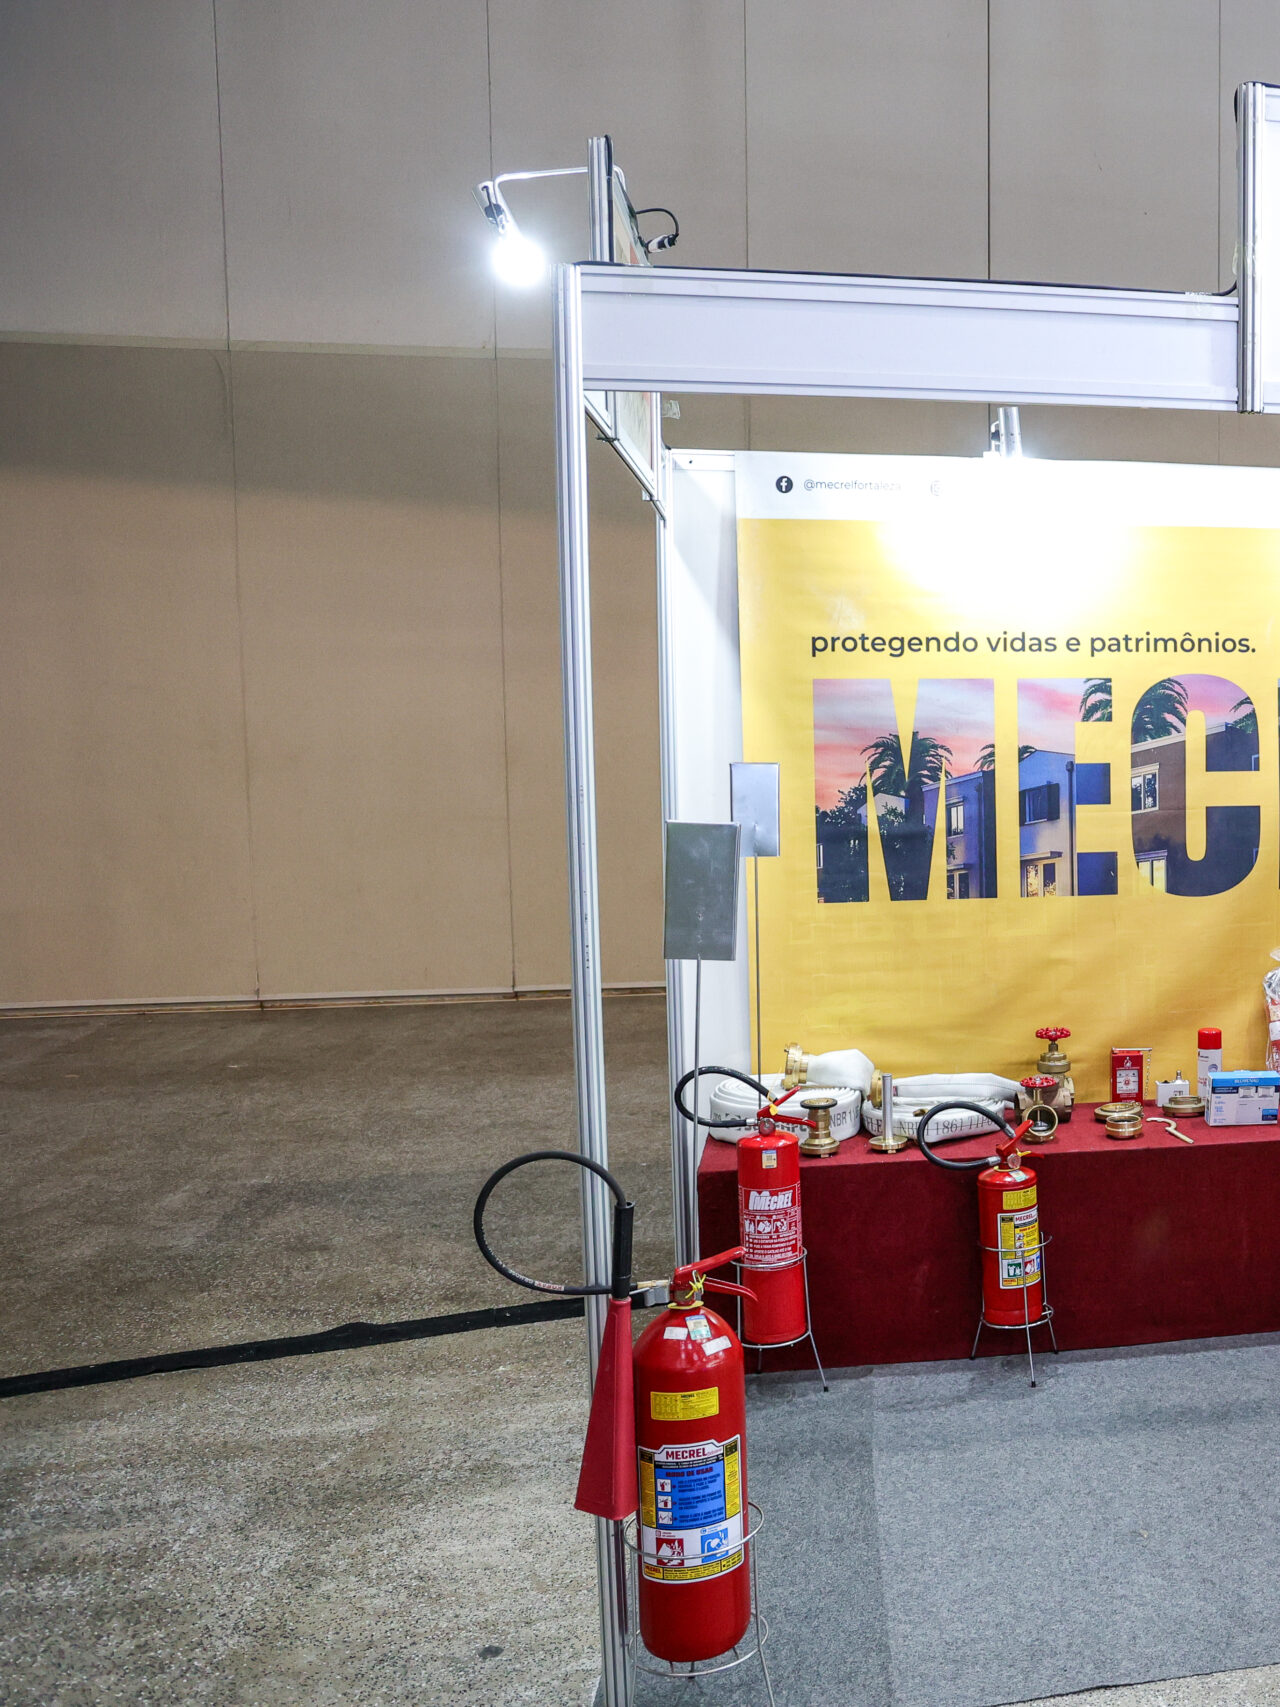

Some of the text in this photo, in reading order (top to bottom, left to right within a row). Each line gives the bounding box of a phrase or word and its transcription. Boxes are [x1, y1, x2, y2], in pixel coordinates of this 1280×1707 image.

[810, 630, 1257, 659] protegendo vidas e patrimônios.
[752, 1190, 793, 1211] MECREL
[1015, 1213, 1033, 1222] MECREL
[665, 1447, 707, 1460] MECREL
